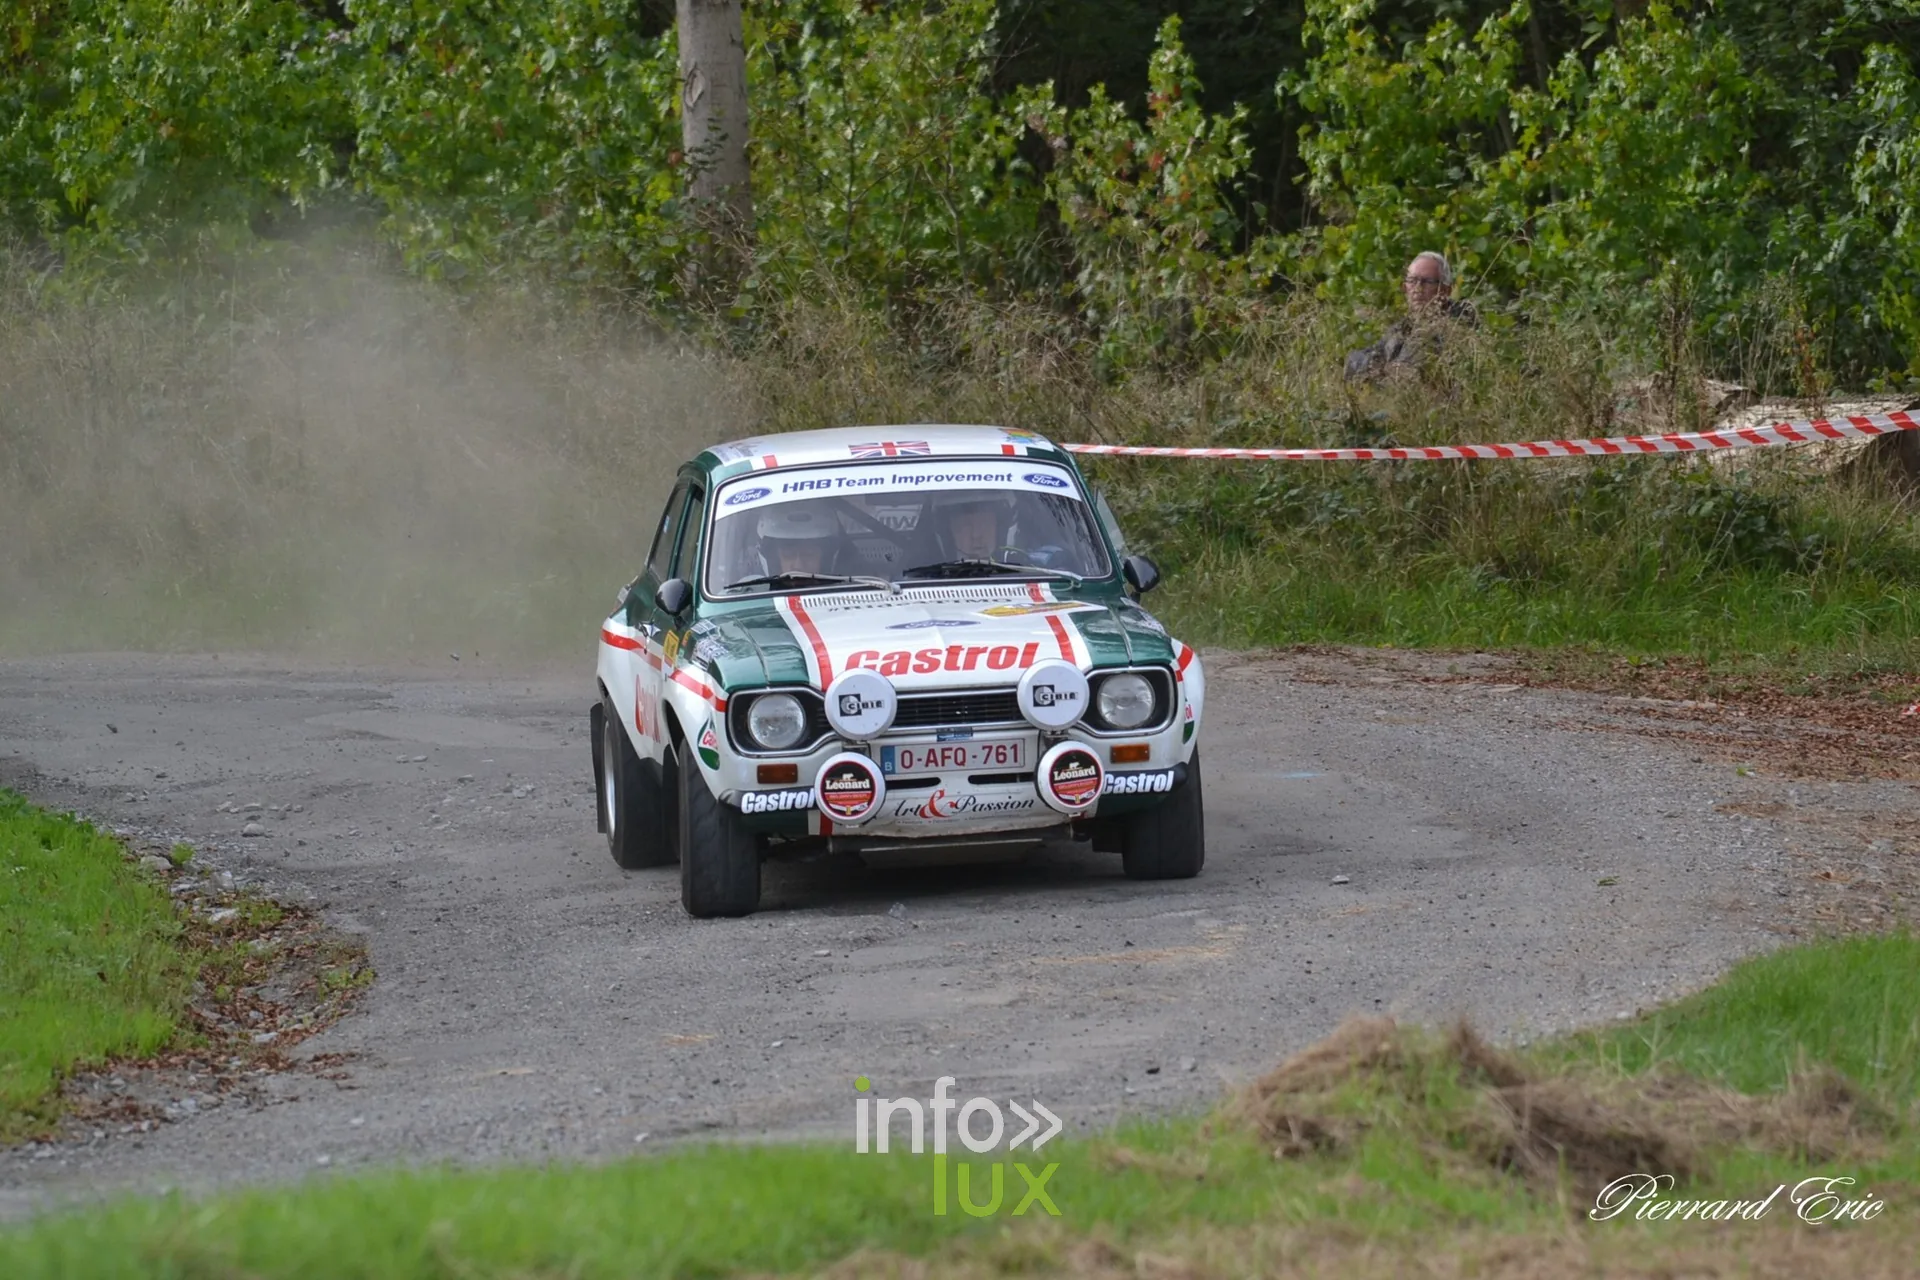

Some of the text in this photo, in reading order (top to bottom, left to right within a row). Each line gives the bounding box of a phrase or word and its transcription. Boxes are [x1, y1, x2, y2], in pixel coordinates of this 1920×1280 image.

[835, 477, 885, 488] Team
[892, 472, 1012, 485] Improvement
[1031, 474, 1061, 486] Ford
[732, 489, 763, 503] Ford
[845, 642, 1040, 677] Castrol
[884, 761, 893, 771] B
[1053, 765, 1096, 781] Leonard
[825, 779, 870, 790] Leonard
[1103, 771, 1174, 794] Castrol
[741, 788, 815, 814] Castrol
[919, 788, 954, 818] &
[954, 795, 1034, 813] Passion
